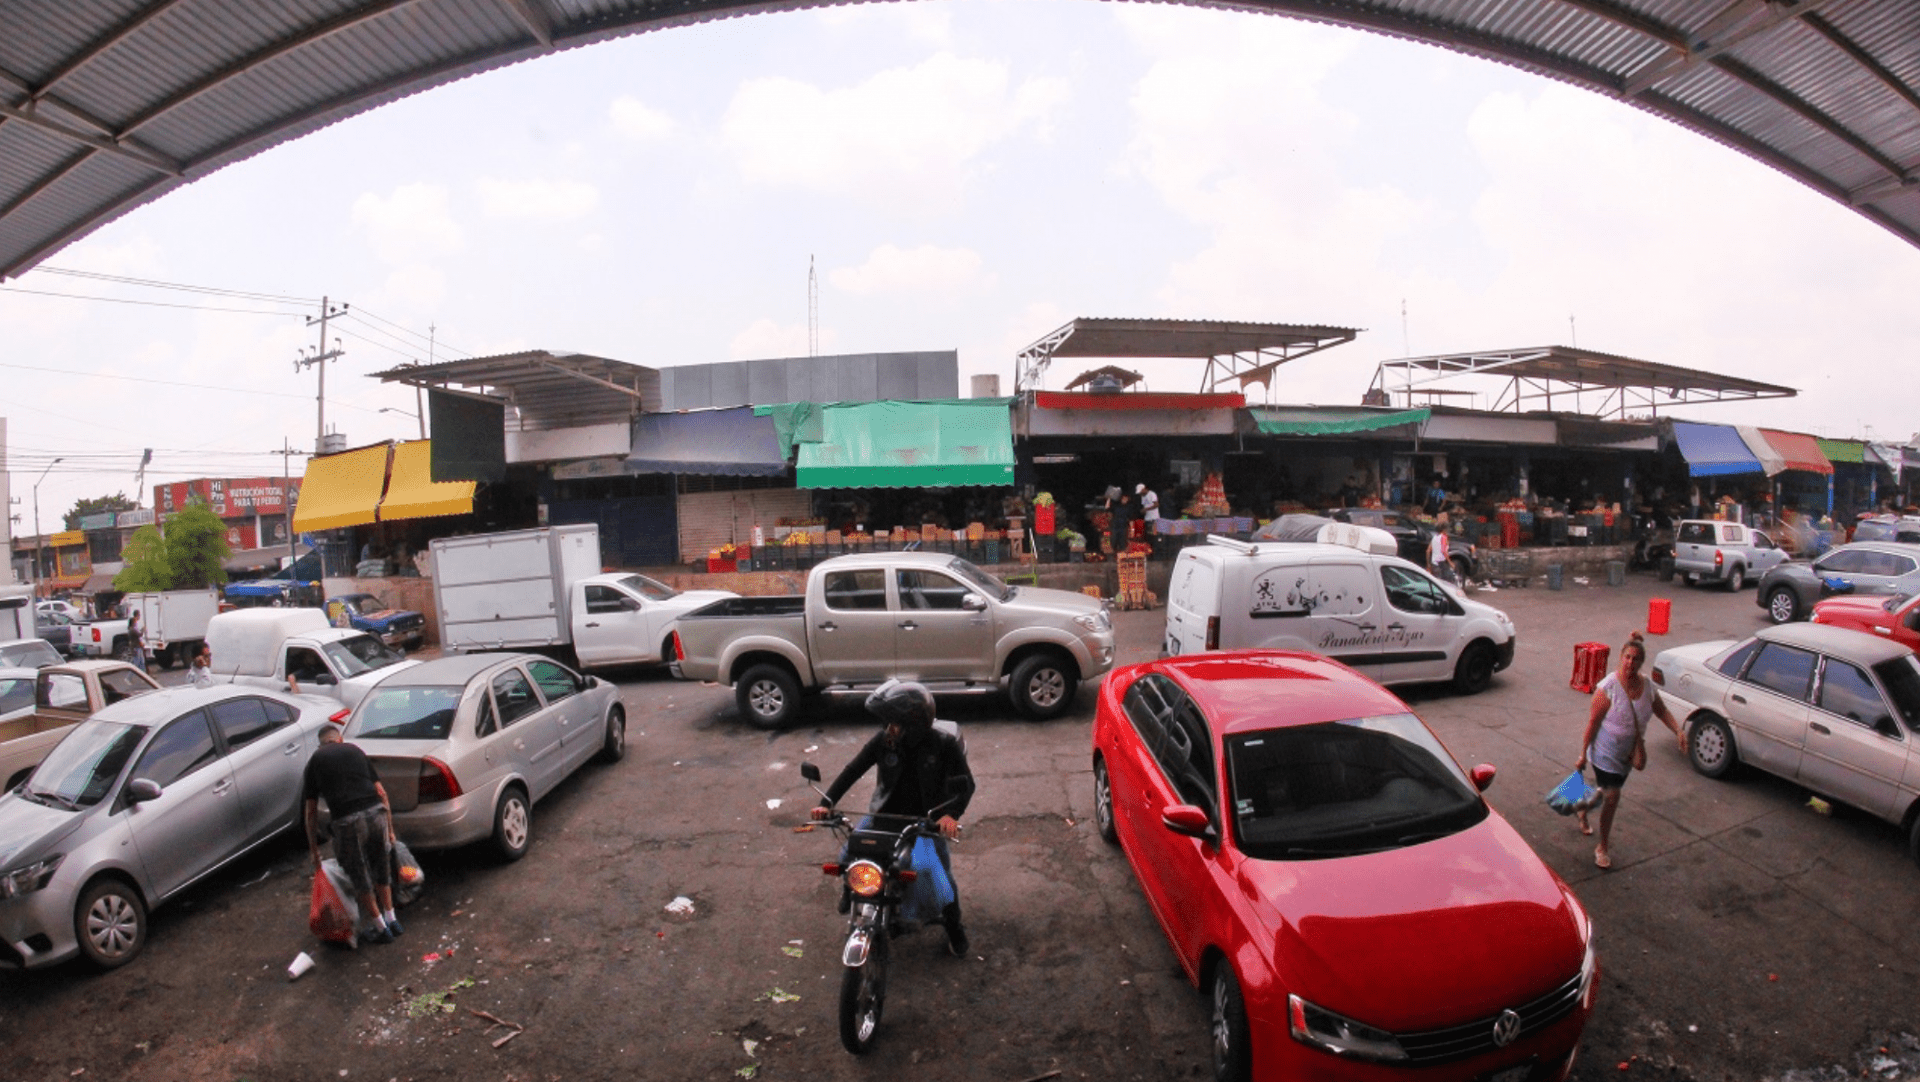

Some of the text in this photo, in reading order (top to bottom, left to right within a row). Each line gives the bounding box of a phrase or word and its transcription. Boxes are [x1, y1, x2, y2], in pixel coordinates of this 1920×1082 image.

[211, 481, 221, 491] Hi
[211, 492, 224, 501] Pro
[233, 498, 251, 507] PARA
